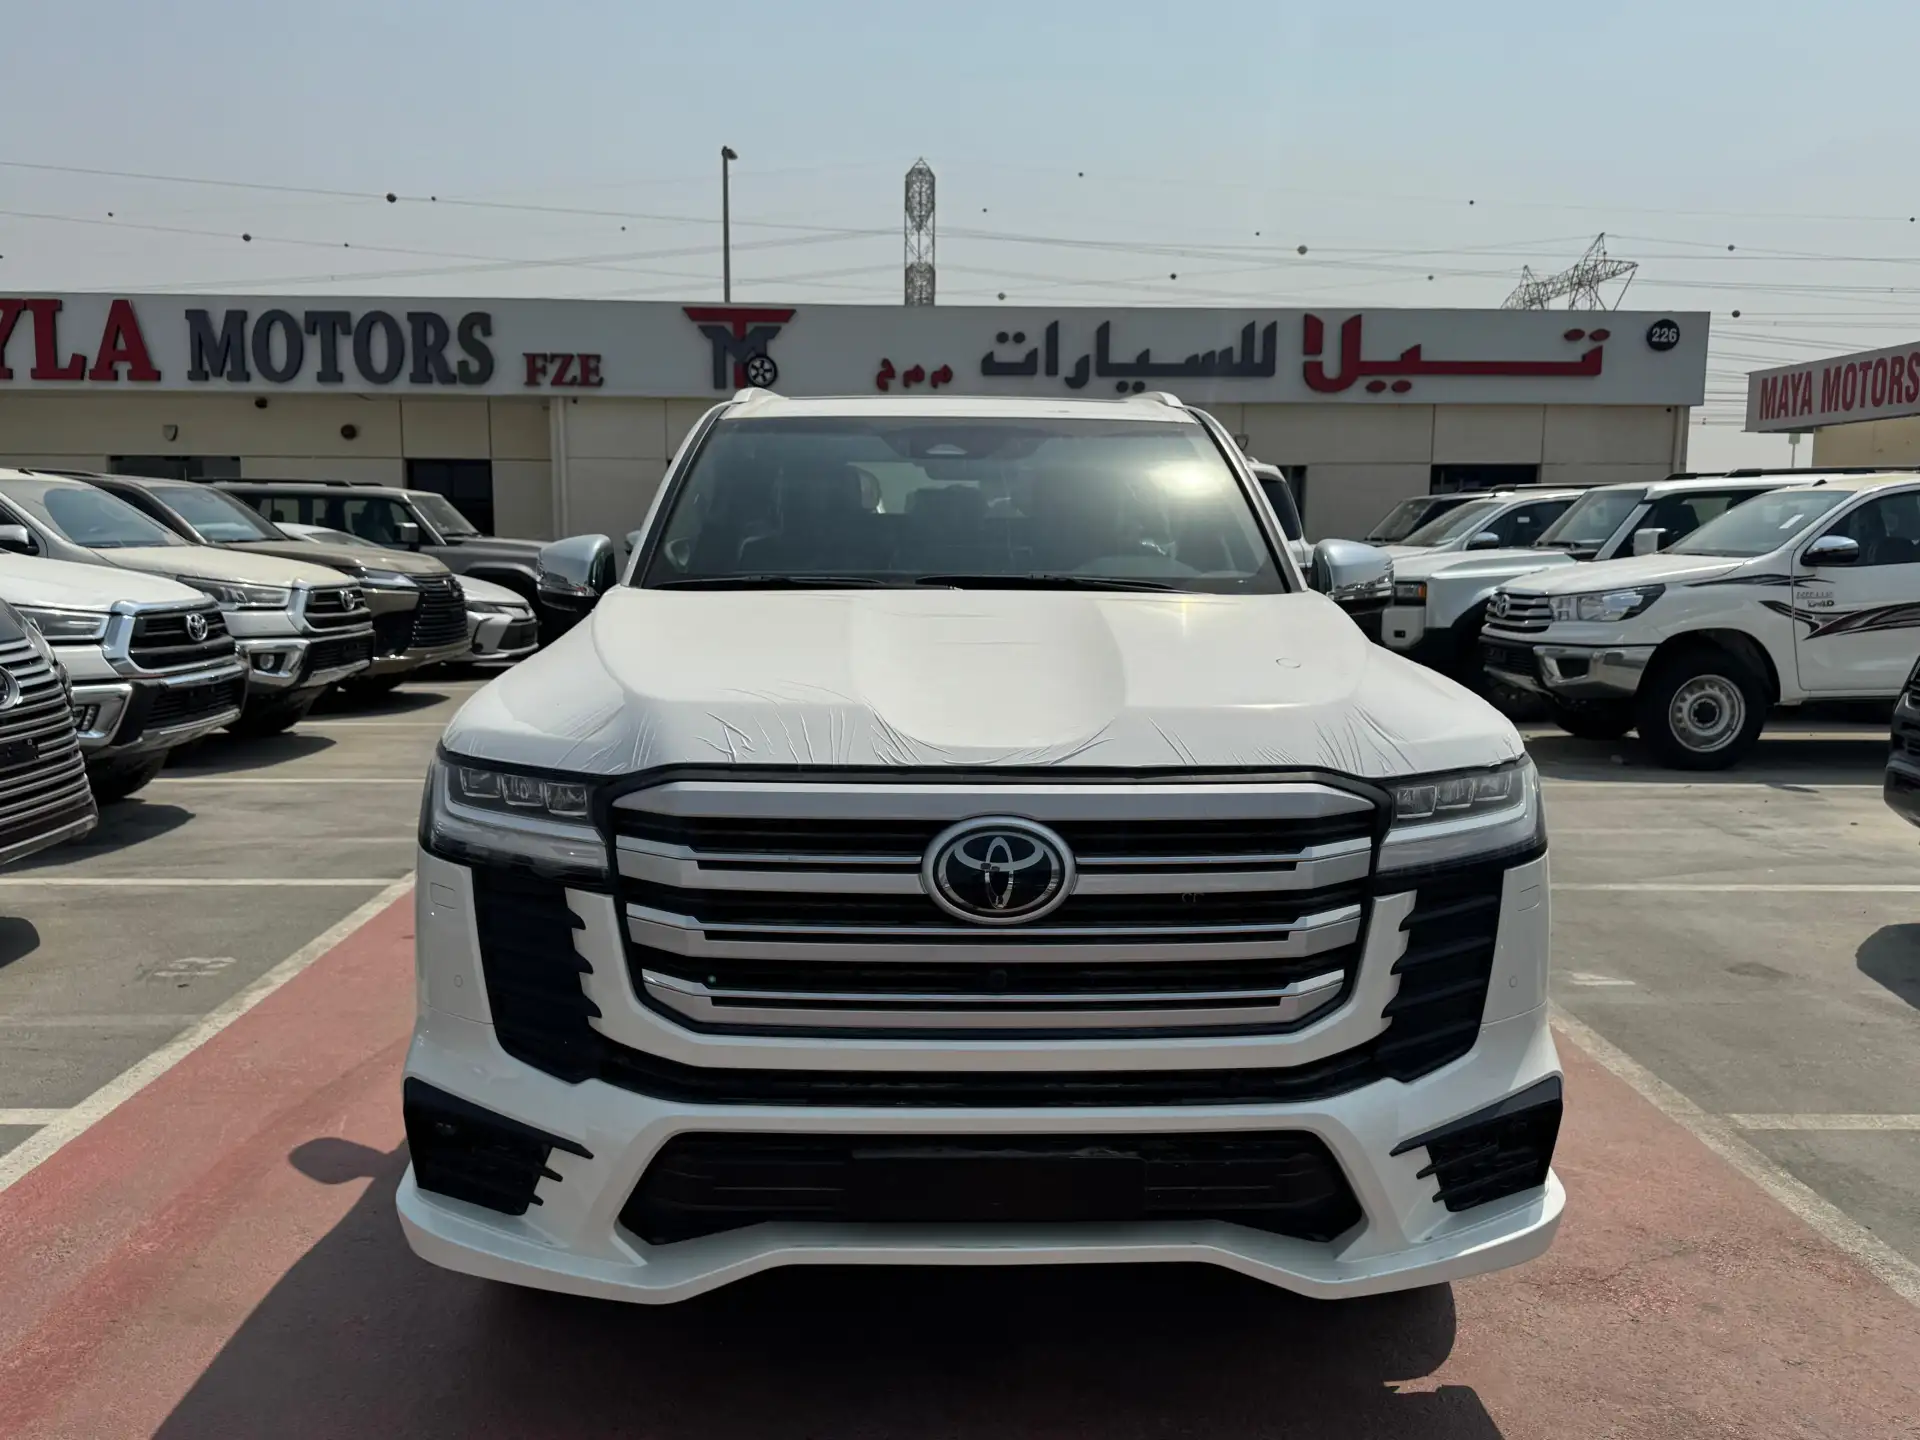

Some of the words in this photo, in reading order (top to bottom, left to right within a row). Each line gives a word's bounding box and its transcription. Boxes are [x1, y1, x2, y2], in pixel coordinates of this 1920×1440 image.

[185, 309, 494, 385] MOTORS
[522, 352, 604, 387] FZE
[981, 320, 1278, 390] للسيارات
[1303, 313, 1611, 393] تيلا
[1651, 327, 1678, 343] 226
[1759, 370, 1813, 420] MAYA
[1820, 351, 1920, 413] MOTORS
